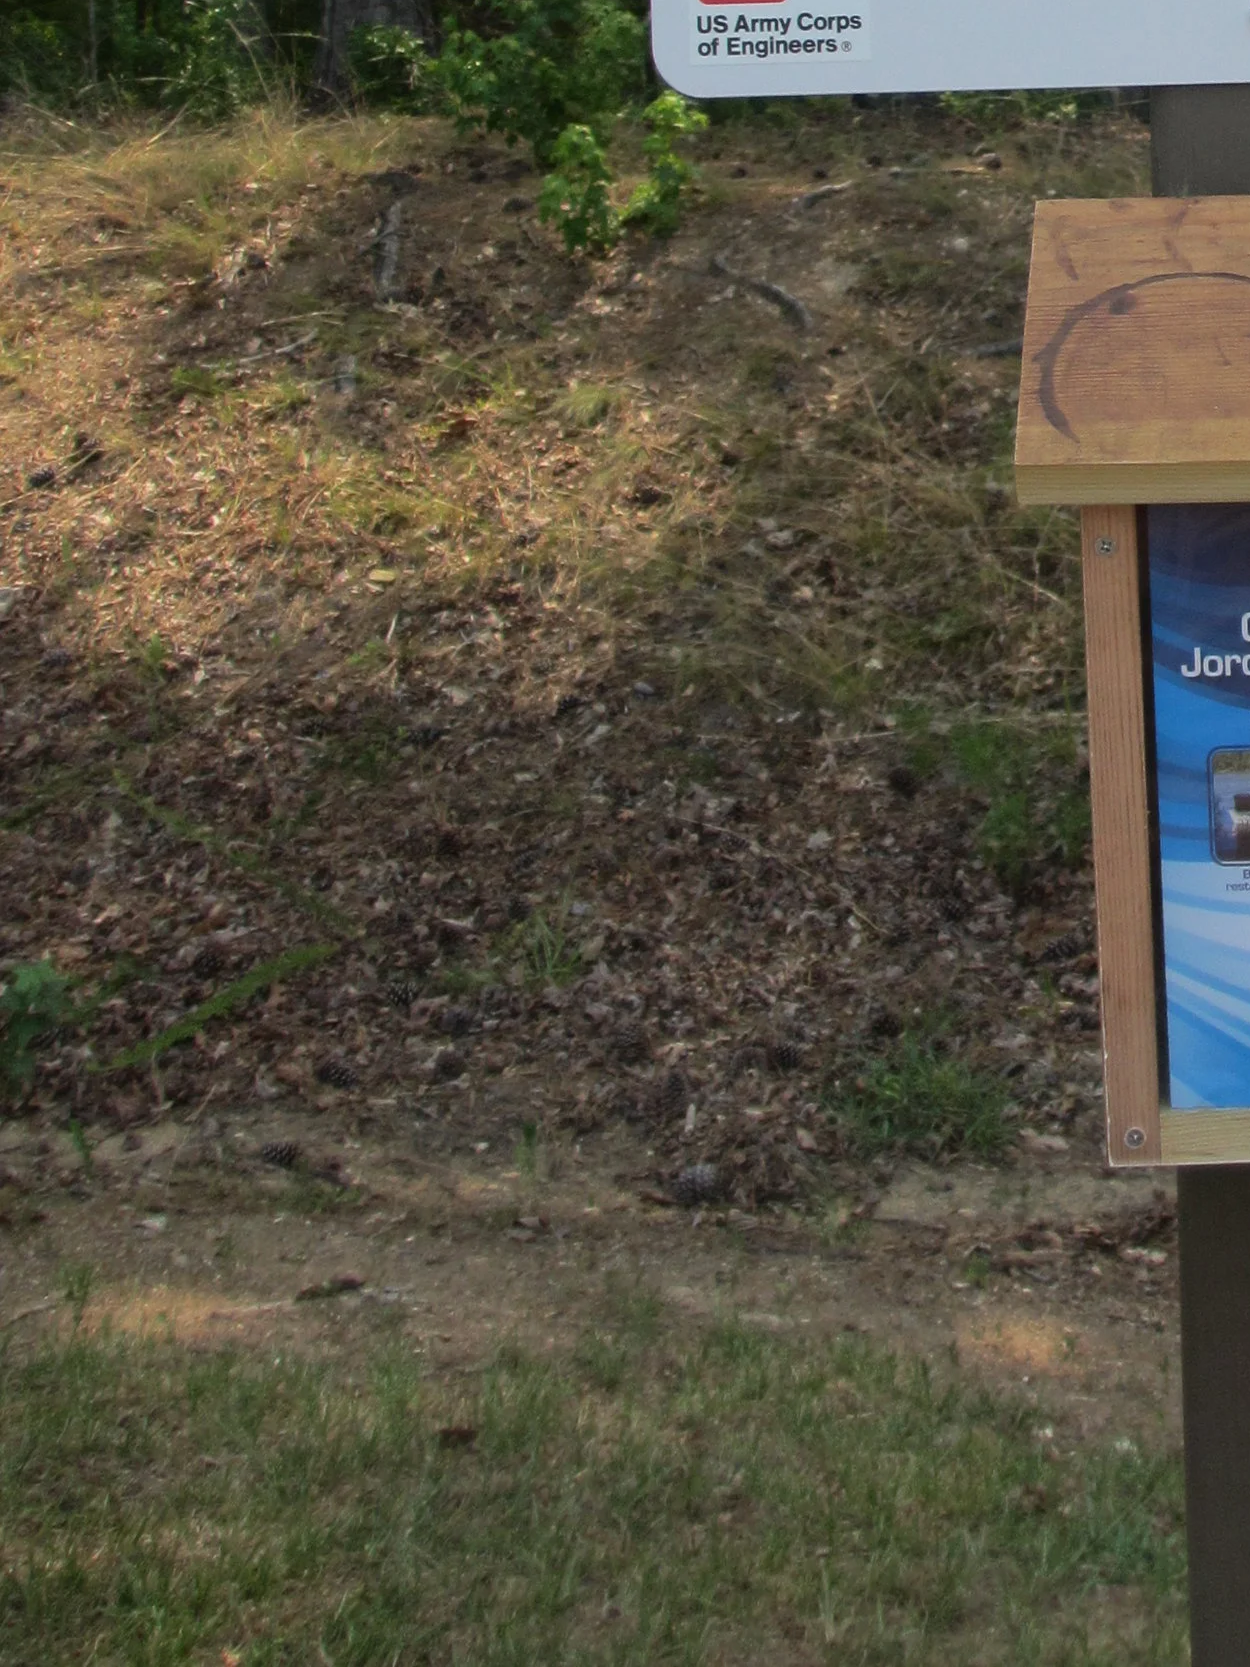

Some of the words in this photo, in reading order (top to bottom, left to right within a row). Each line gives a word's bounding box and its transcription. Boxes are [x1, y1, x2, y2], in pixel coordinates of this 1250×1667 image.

[697, 15, 728, 33] US
[734, 14, 791, 35] Army
[797, 12, 862, 32] Corps
[698, 38, 719, 56] of
